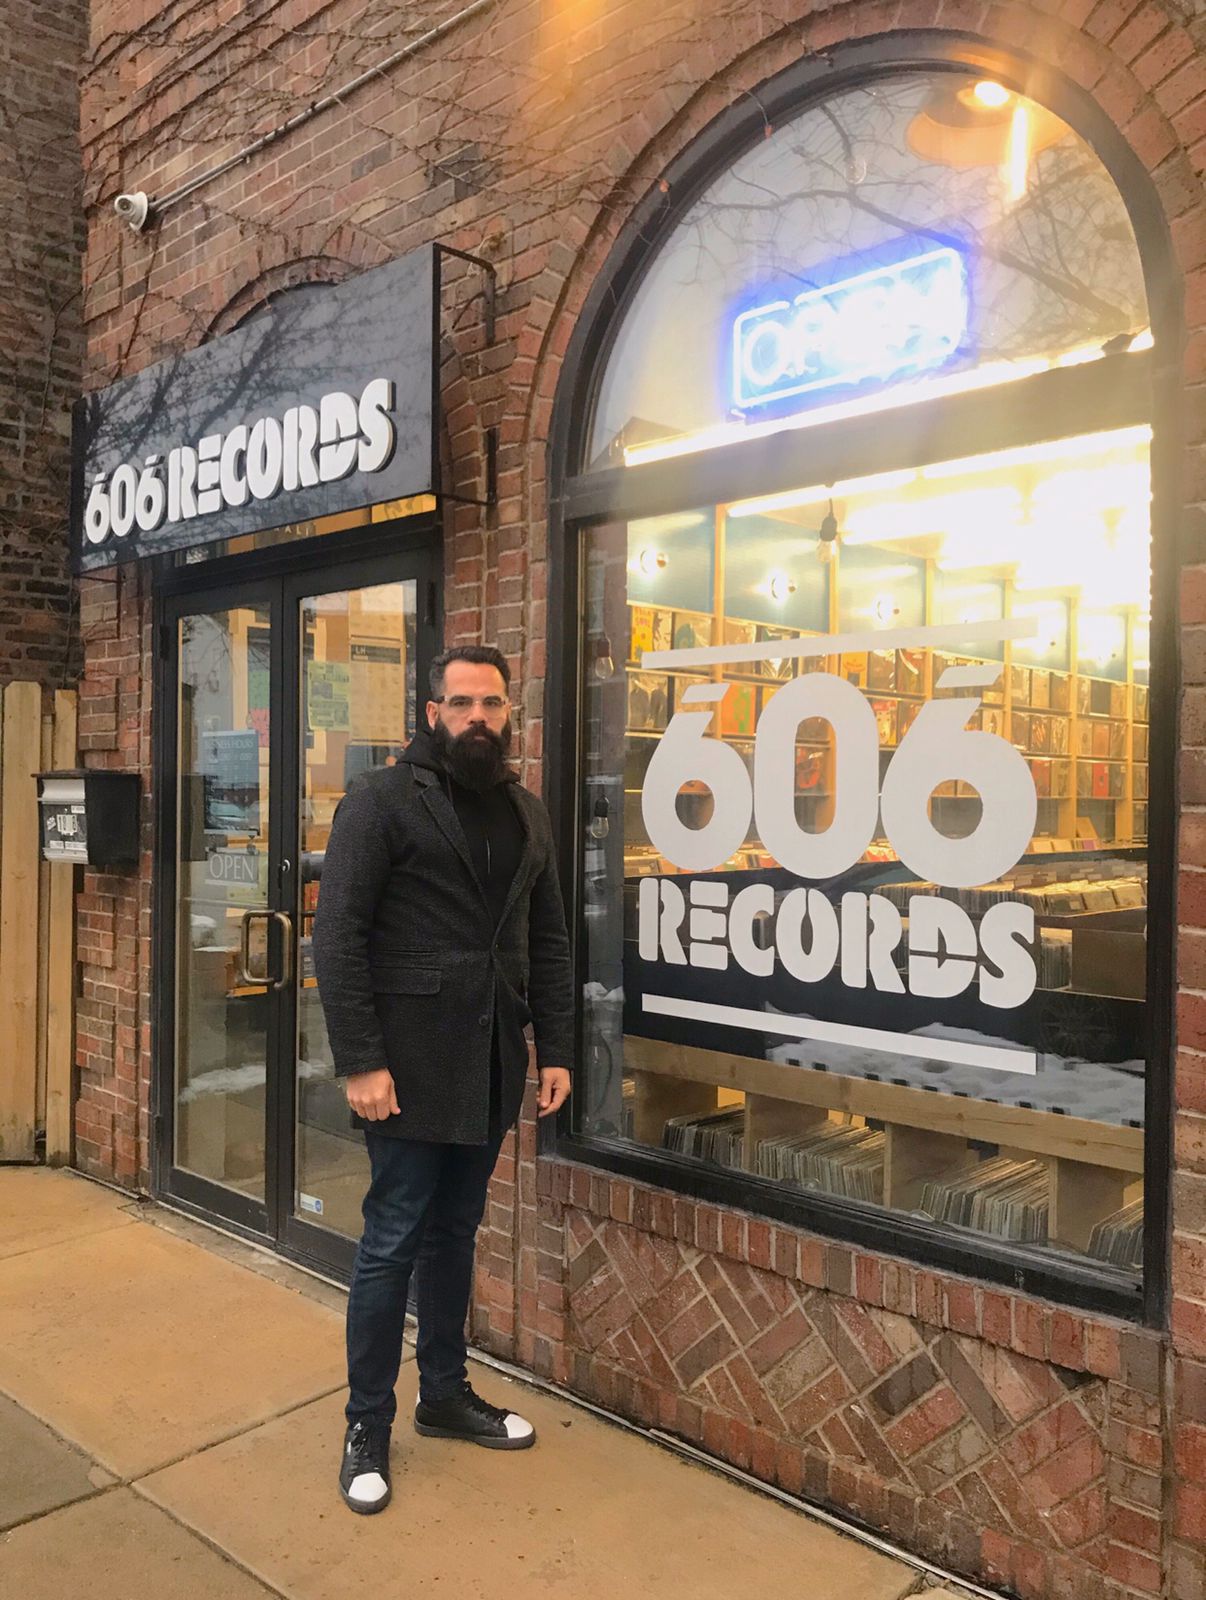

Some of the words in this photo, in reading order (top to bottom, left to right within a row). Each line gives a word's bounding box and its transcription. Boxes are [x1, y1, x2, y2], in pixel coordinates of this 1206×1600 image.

[746, 266, 957, 386] OPN
[85, 454, 166, 544] 606
[168, 379, 396, 521] RECORDS
[643, 665, 1037, 887] 606
[209, 853, 254, 880] OPEN
[639, 878, 1037, 1008] RECORDS
